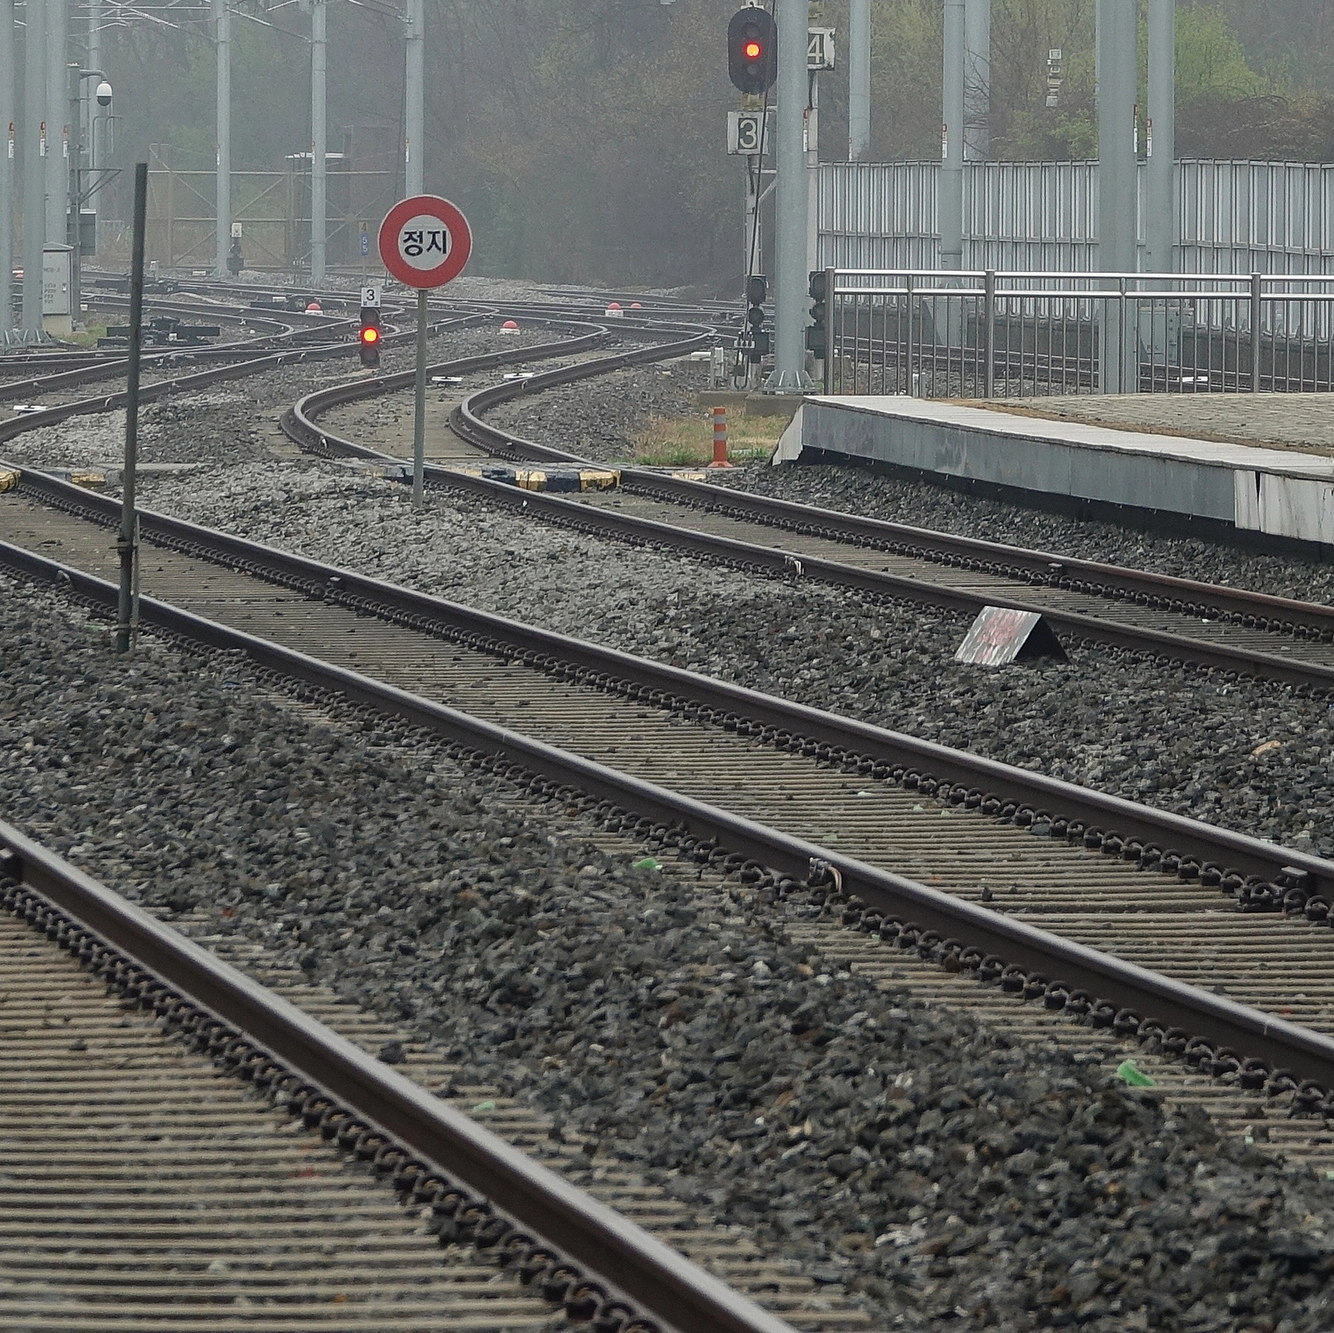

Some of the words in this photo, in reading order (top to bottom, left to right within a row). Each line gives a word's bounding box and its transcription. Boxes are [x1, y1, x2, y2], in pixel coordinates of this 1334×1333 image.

[807, 34, 823, 64] 4
[739, 119, 757, 149] 3
[402, 230, 447, 257] 정지
[366, 289, 375, 301] 3
